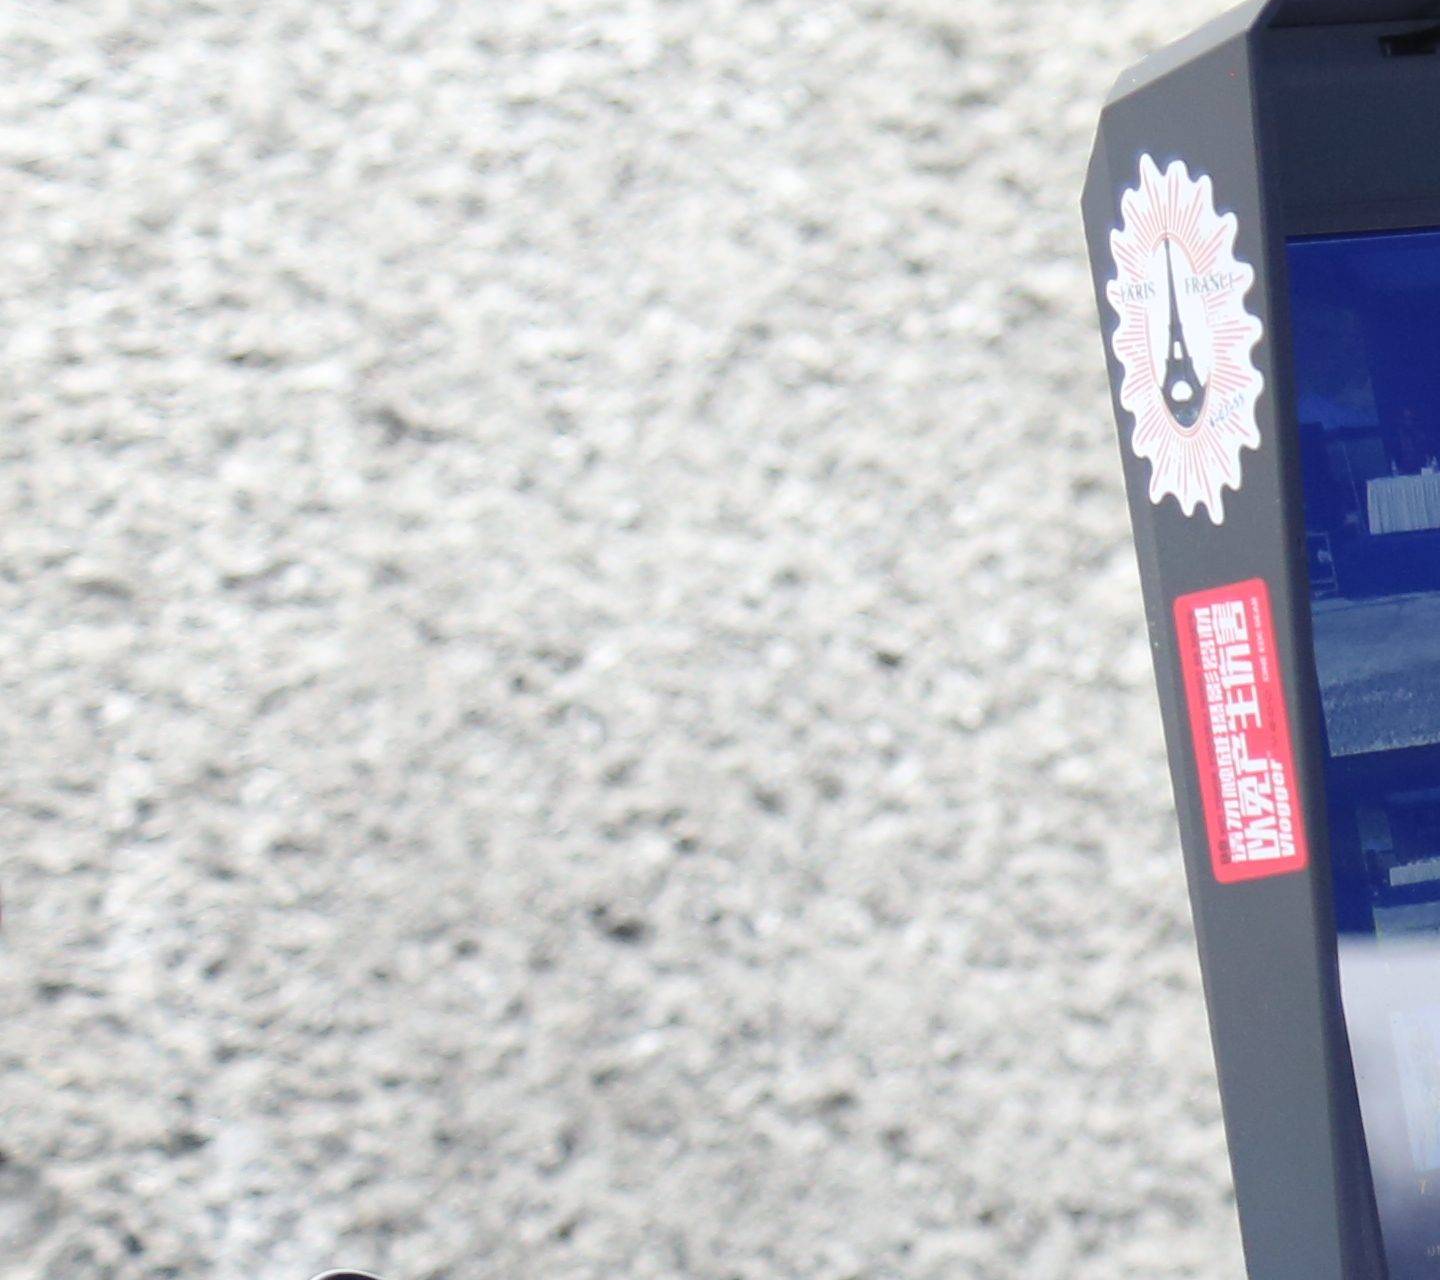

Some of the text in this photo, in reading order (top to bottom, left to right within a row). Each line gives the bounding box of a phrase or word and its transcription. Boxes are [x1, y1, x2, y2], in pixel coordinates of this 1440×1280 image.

[1211, 600, 1281, 860] 以免产生伤害
[1270, 759, 1296, 857] Vlogger
